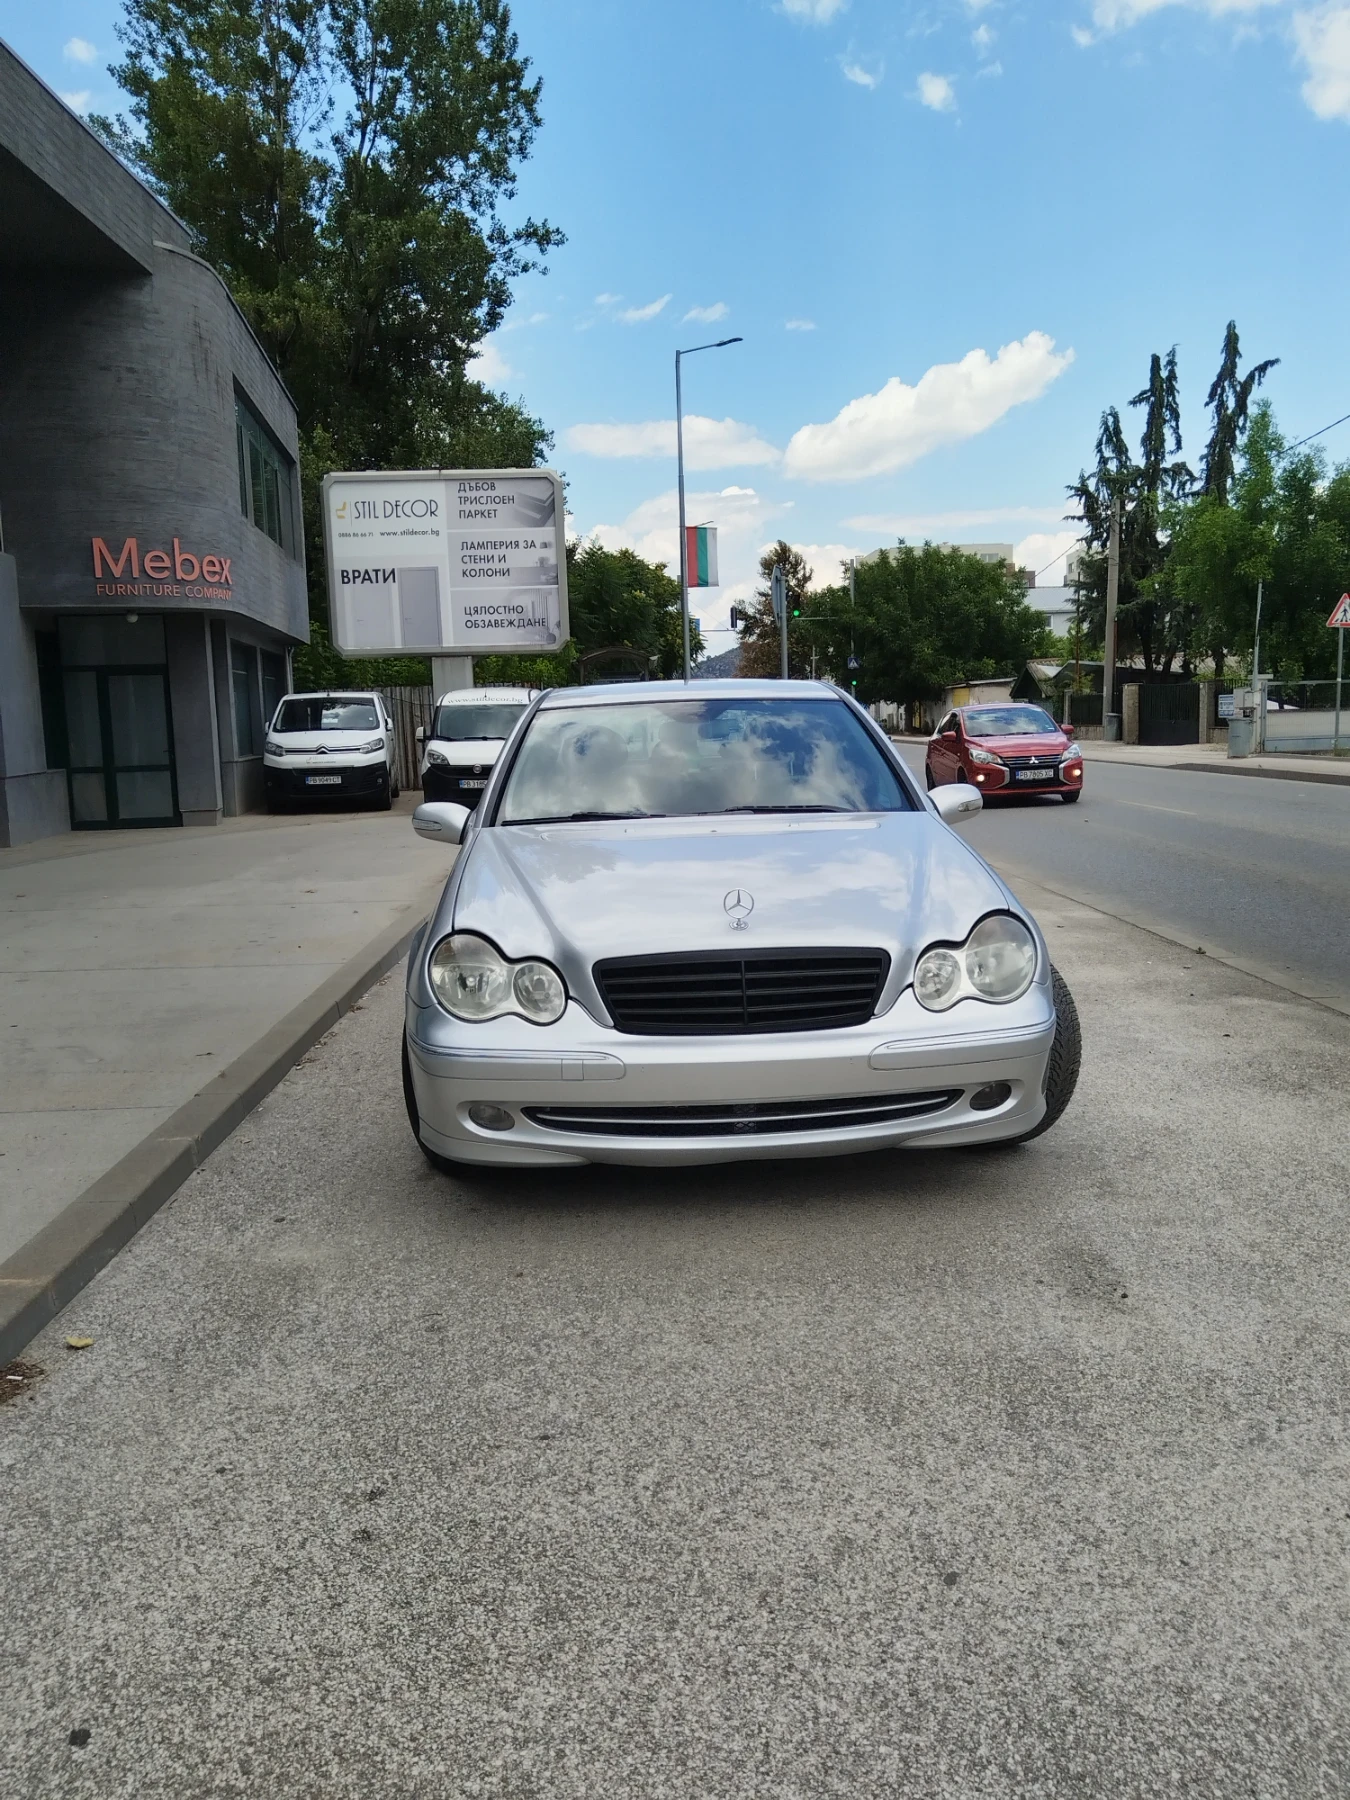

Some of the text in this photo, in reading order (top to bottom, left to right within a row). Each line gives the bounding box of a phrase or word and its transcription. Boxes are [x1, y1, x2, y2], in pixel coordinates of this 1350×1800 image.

[458, 481, 496, 493] ДЪБОВ
[458, 494, 515, 506] ТРИСЛОЕН
[354, 499, 439, 520] STIL DECOR
[458, 509, 498, 519] ПАРКЕТ
[380, 528, 440, 537] www.stildecor.bg
[461, 540, 536, 550] ЛАМПЕРИЯ ЗА
[92, 538, 232, 585] Mebex
[461, 554, 506, 564] СТЕНИ И
[341, 568, 396, 585] ВРАТИ
[462, 568, 510, 578] КОЛОНИ
[96, 584, 232, 600] FURNITURE COMPANY
[464, 605, 524, 616] ЦЯЛОСТНО
[464, 618, 547, 629] ОБЗАВЕЖДАНЕ
